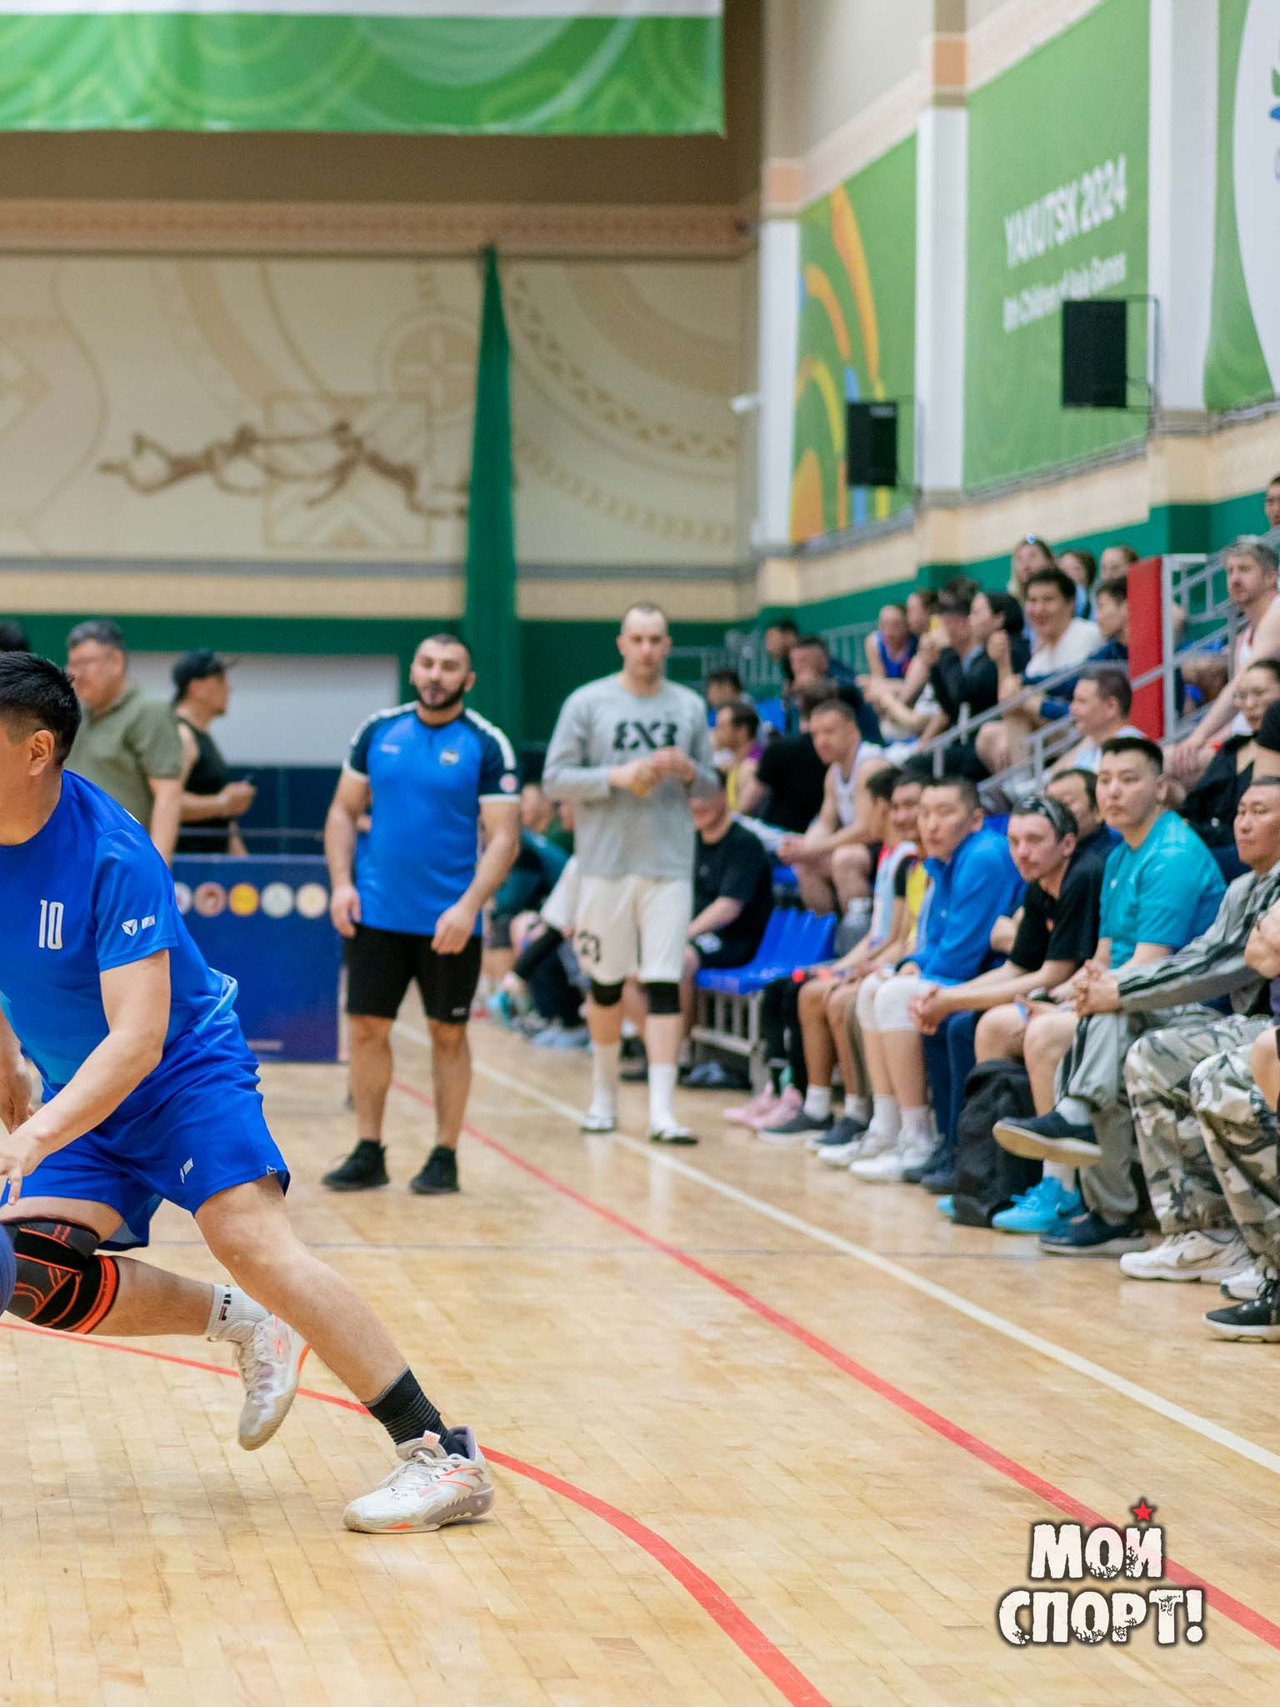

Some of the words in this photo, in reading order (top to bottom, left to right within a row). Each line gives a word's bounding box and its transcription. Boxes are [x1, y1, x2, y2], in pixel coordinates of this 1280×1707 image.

[1003, 179, 1079, 268] YAKUTSK
[1079, 151, 1127, 233] 2024
[38, 899, 65, 950] 10
